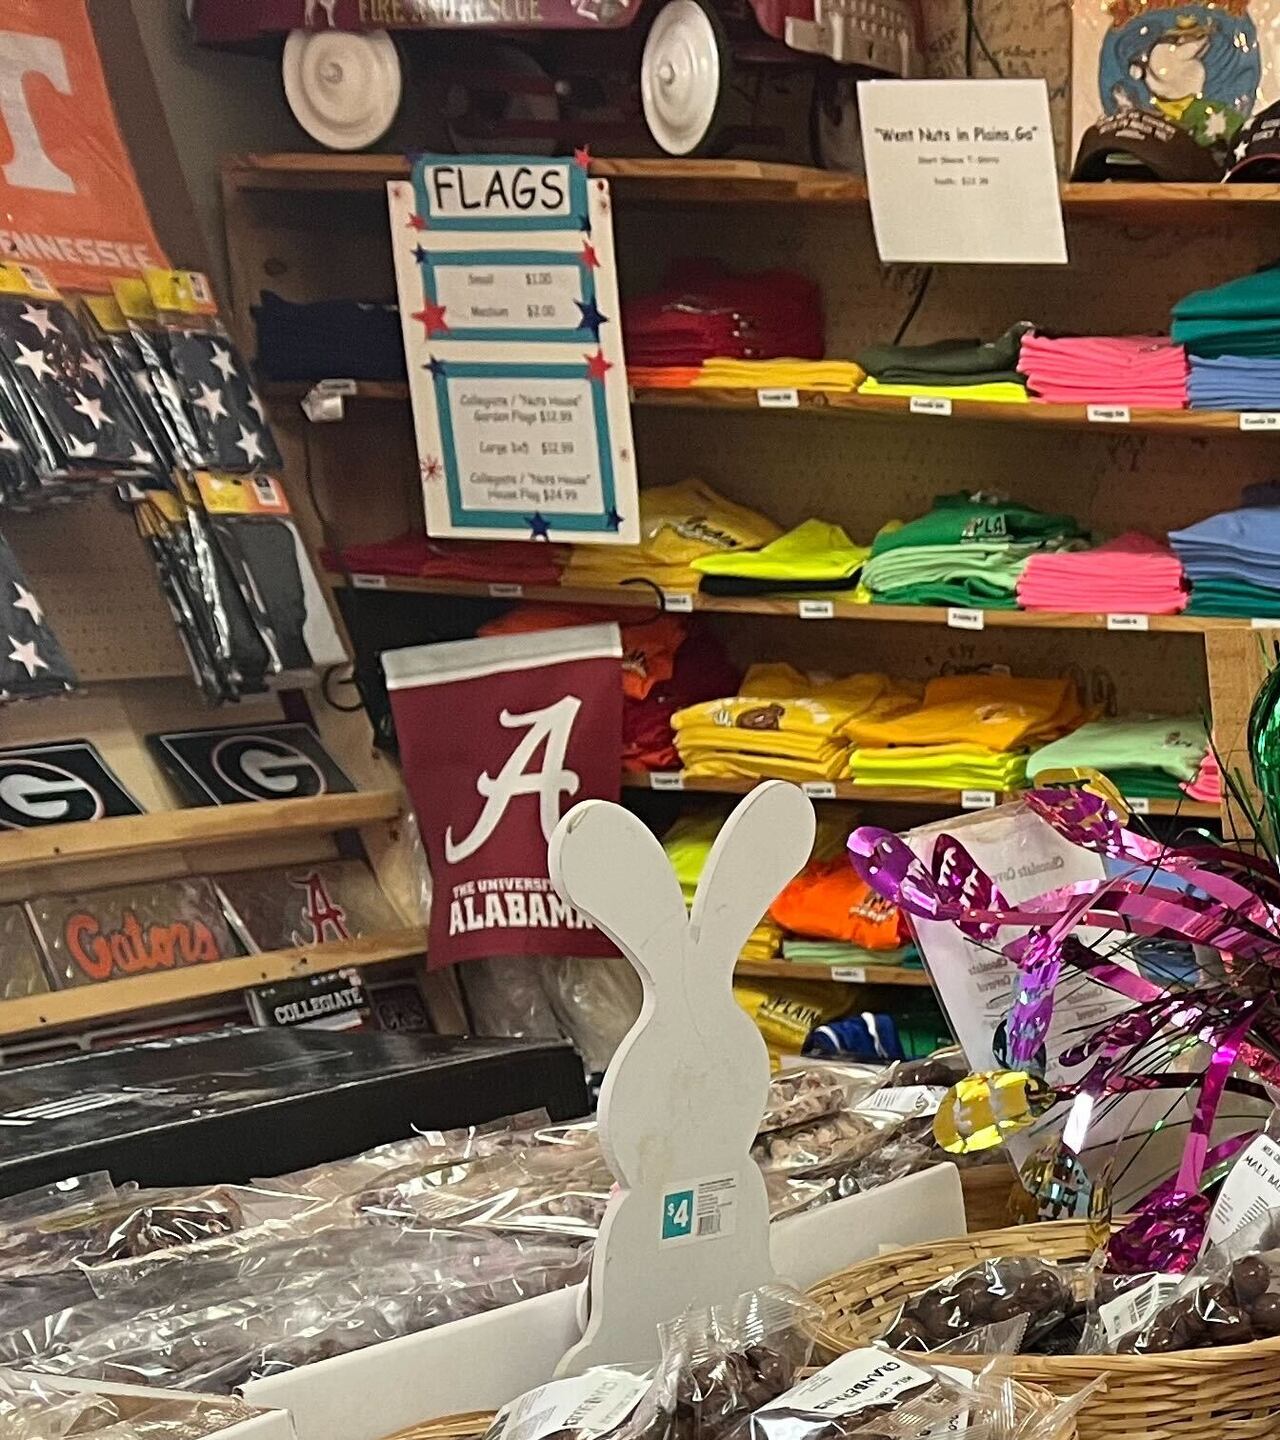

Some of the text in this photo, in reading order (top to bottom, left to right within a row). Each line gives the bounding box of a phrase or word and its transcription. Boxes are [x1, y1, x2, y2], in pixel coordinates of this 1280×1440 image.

[918, 127, 950, 142] Nuts
[956, 127, 970, 142] in
[432, 166, 564, 211] FLAGS
[444, 695, 583, 865] A
[452, 880, 476, 900] THE
[65, 911, 220, 980] Gators
[273, 984, 364, 1026] COLLEGIATE
[1245, 1155, 1269, 1178] MALT
[667, 1198, 689, 1228] $4
